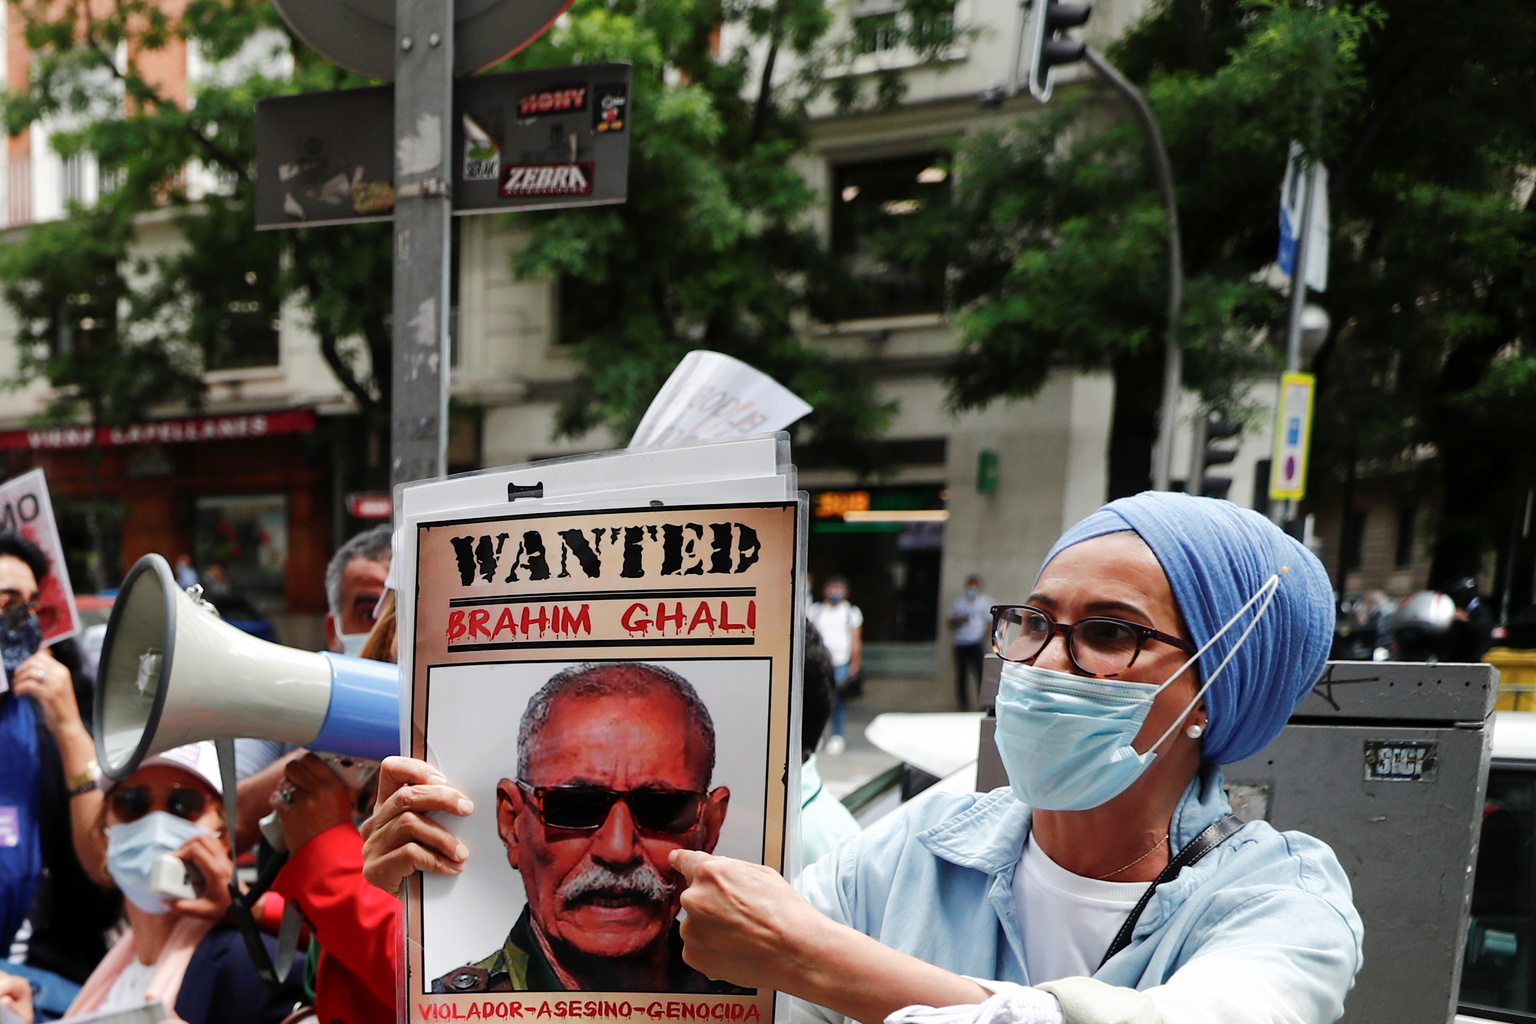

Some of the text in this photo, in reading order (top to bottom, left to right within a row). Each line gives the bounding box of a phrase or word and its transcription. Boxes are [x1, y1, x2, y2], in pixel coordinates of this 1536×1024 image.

[504, 164, 587, 190] ZEBRA
[450, 521, 762, 587] WANTED
[446, 600, 757, 646] BRAHIM GHALI
